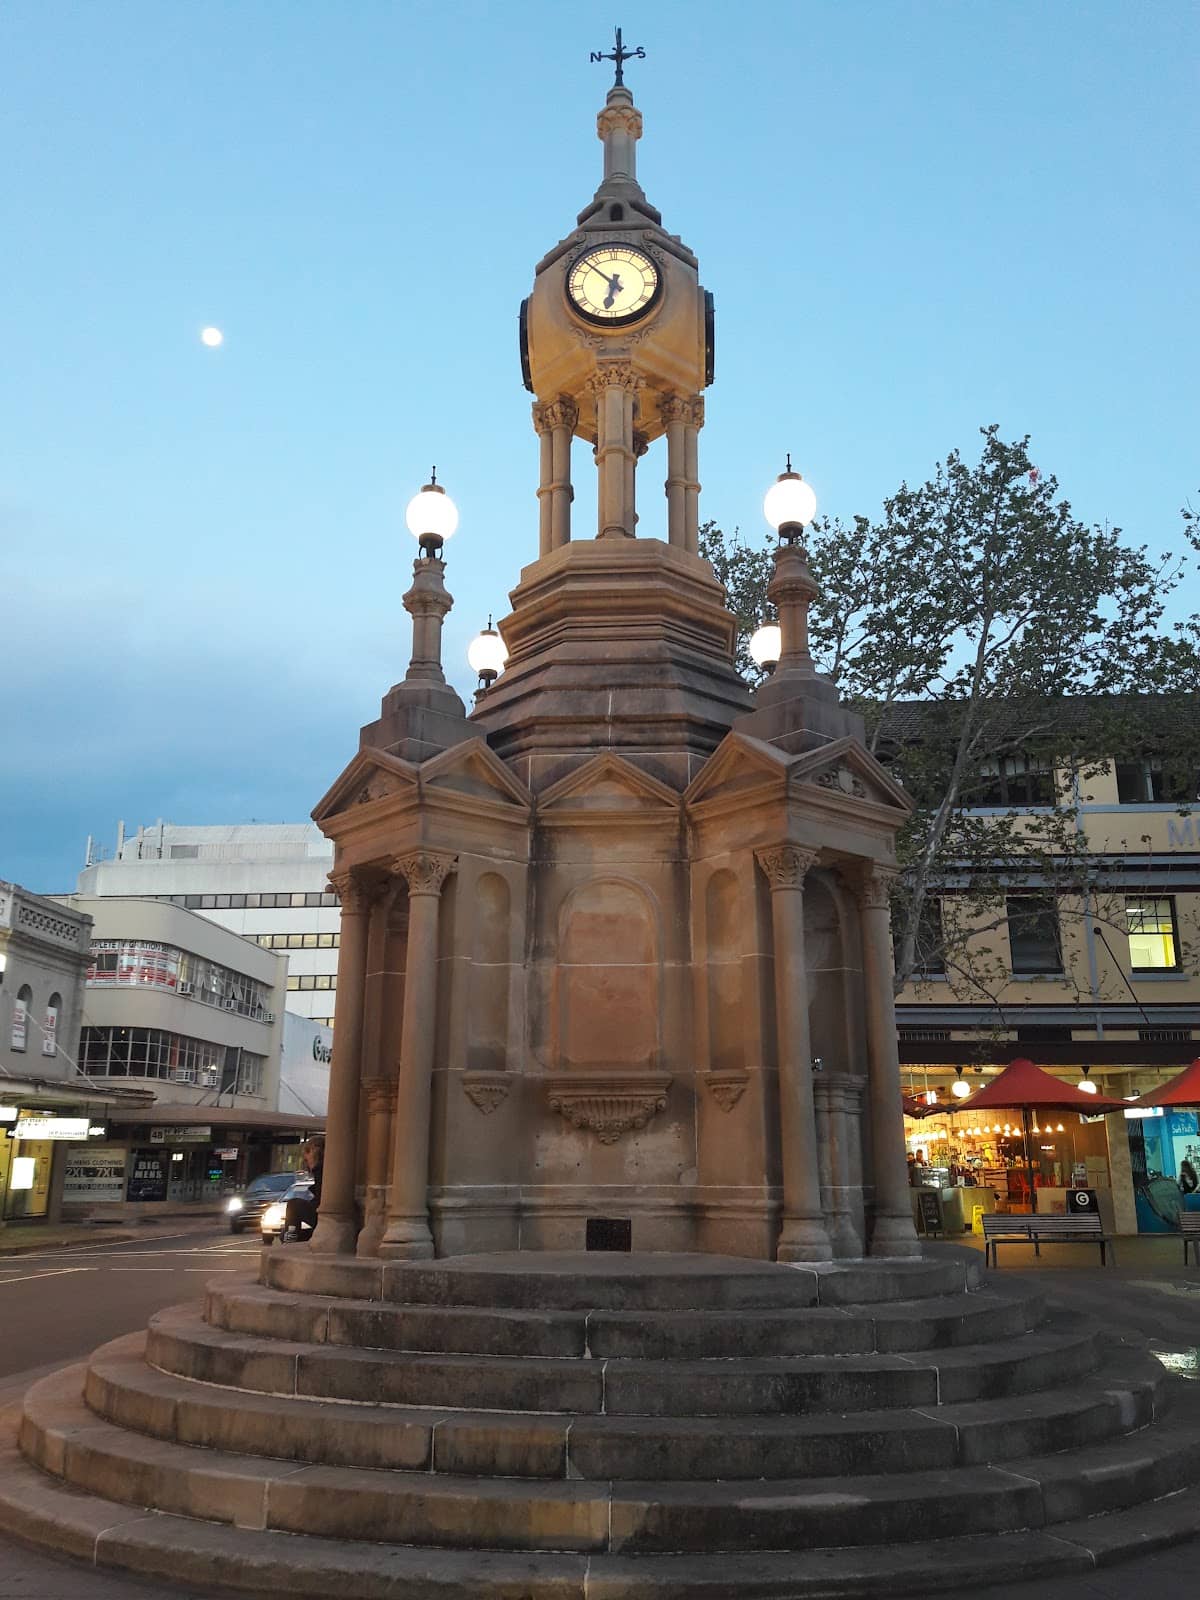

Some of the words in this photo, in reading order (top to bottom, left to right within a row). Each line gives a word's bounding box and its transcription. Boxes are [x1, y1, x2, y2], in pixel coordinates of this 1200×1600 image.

[590, 51, 602, 63] N
[636, 46, 647, 59] S
[138, 1161, 160, 1170] BIG
[65, 1167, 85, 1178] 2XL
[96, 1167, 117, 1178] 7XL
[134, 1170, 162, 1179] MENS
